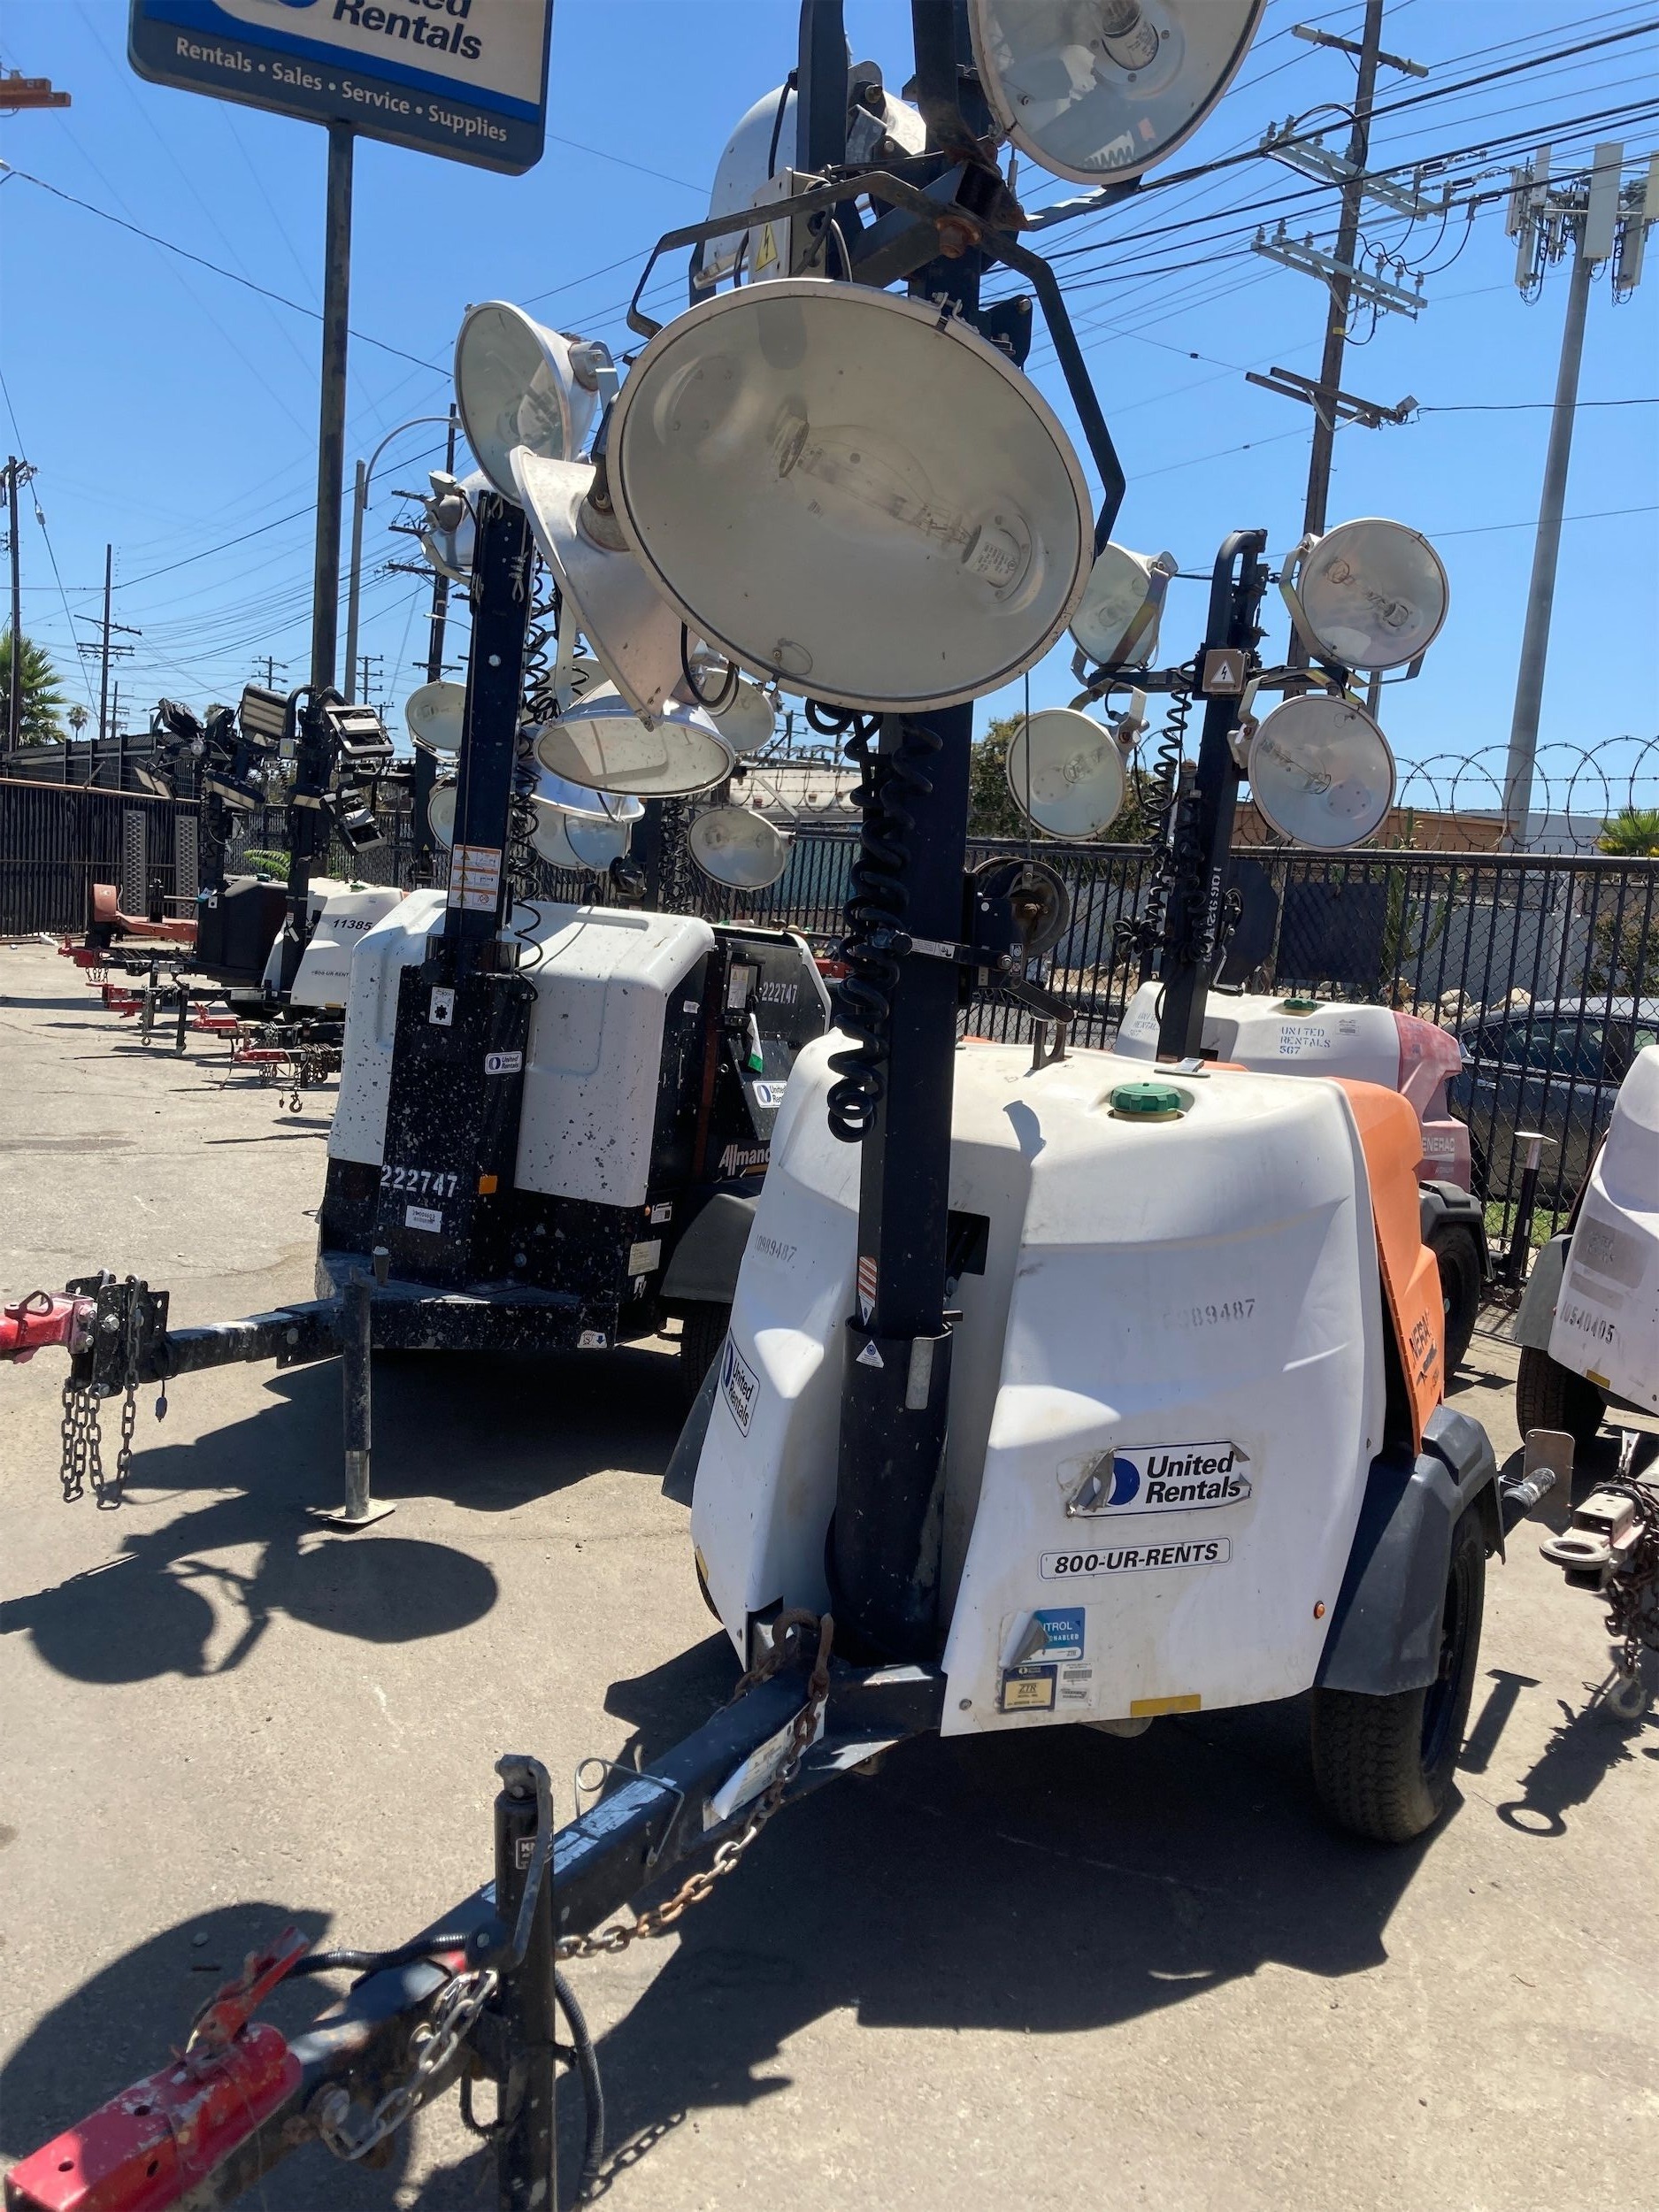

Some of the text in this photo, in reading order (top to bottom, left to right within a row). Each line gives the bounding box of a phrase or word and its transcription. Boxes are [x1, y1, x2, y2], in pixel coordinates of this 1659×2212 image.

[333, 0, 482, 59] Rentals
[176, 36, 507, 142] Rentals Sales Service Supplies
[334, 918, 373, 931] 11385
[762, 981, 798, 1004] 222747
[1280, 1036, 1331, 1048] RENTALS
[1281, 1026, 1325, 1037] UNITED
[1279, 1045, 1301, 1054] 567
[1422, 1137, 1455, 1152] ENERAC
[380, 1164, 458, 1198] 222747
[732, 1357, 755, 1402] United
[728, 1379, 749, 1427] Rentals
[1147, 1450, 1234, 1479] United
[1145, 1476, 1241, 1504] Rentals
[1055, 1542, 1219, 1574] 800-UR-RENTS
